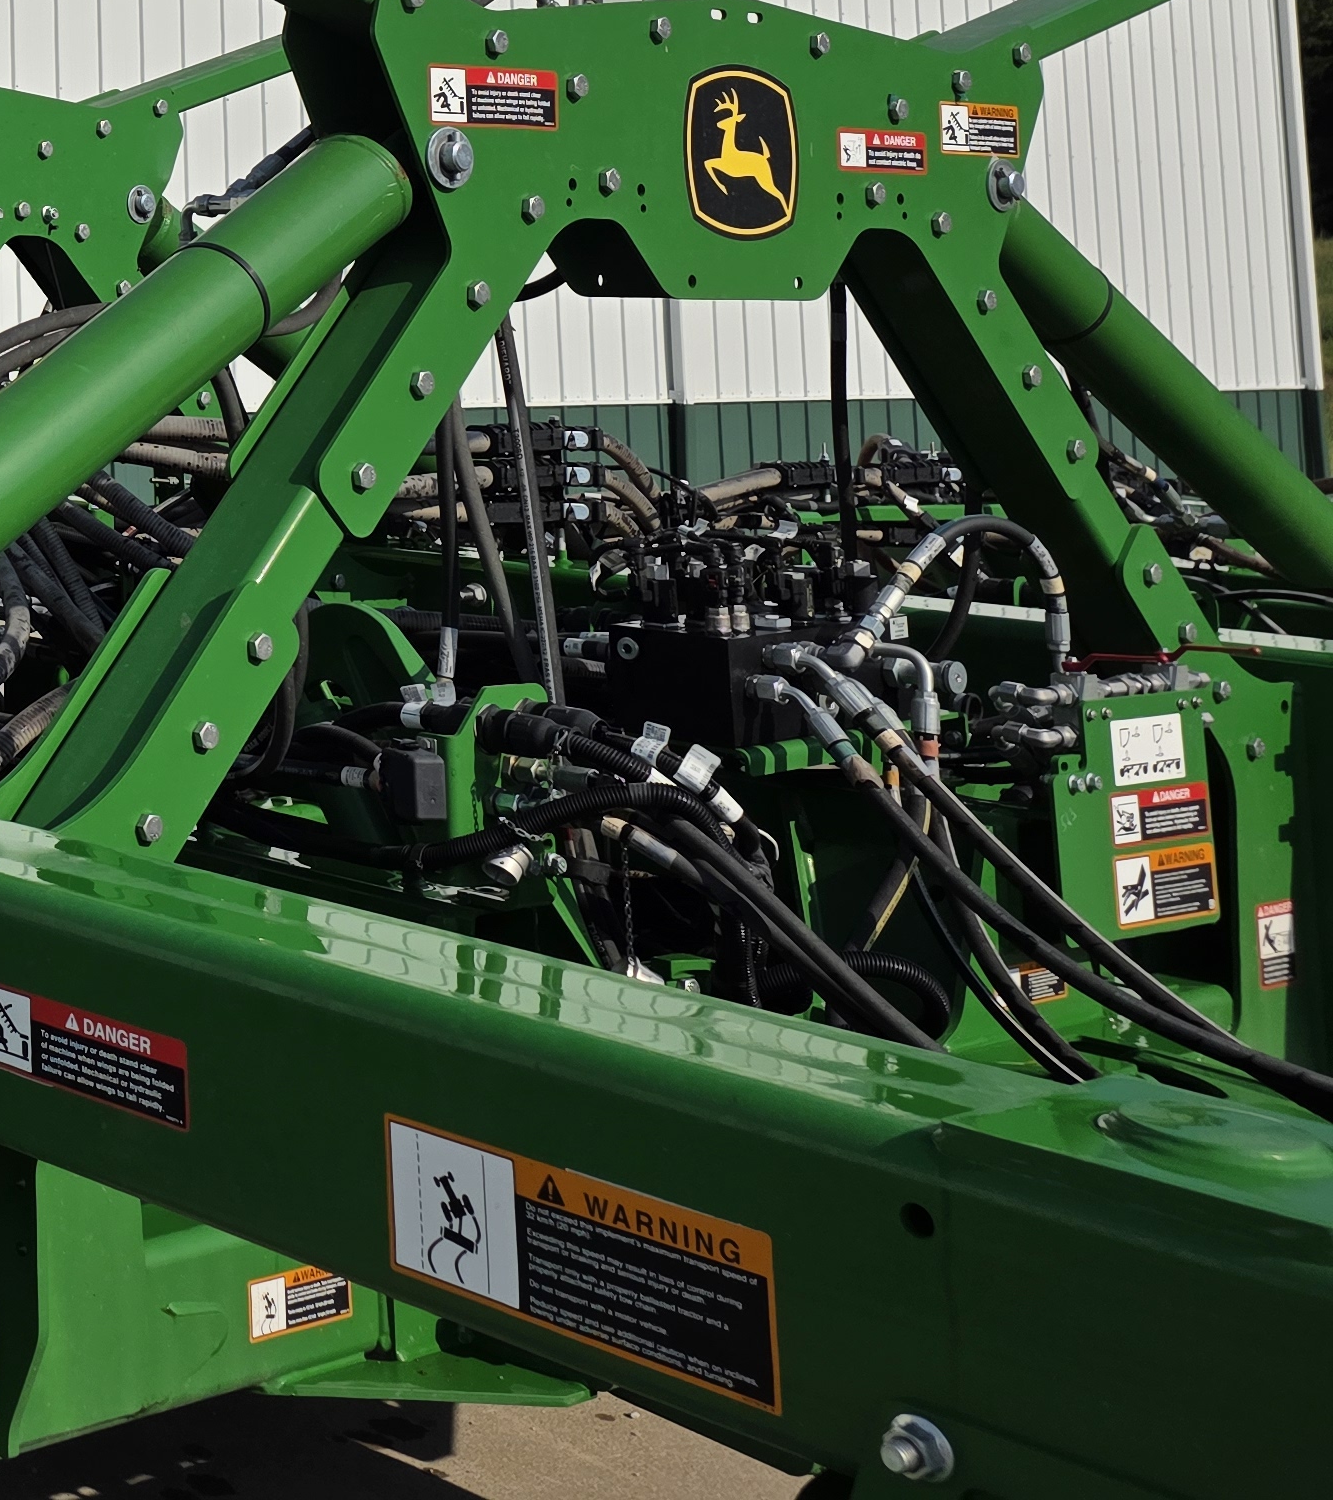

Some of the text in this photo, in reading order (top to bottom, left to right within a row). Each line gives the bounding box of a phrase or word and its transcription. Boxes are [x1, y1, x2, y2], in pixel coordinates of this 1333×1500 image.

[498, 72, 537, 86] DANGER
[980, 107, 1014, 118] WARNING
[884, 135, 916, 146] DANGER
[1160, 788, 1190, 801] DANGER
[1164, 848, 1205, 865] WARNING
[41, 1029, 49, 1038] To
[50, 1035, 68, 1045] avoid
[69, 1040, 89, 1053] injury
[98, 1050, 118, 1061] death
[119, 1057, 139, 1068] stand
[139, 1064, 157, 1074] clear
[83, 1017, 151, 1055] DANGER
[41, 1063, 165, 1112] failure can allow wings to fall rapidly.
[48, 1045, 76, 1058] machine
[77, 1055, 95, 1065] when
[96, 1061, 117, 1073] wings
[118, 1068, 130, 1076] are
[130, 1071, 150, 1085] being
[151, 1078, 174, 1092] folded
[49, 1057, 80, 1071] unfolded.
[81, 1066, 119, 1084] Mechanical
[129, 1082, 162, 1099] hydraulic
[525, 1201, 536, 1212] Do
[537, 1208, 549, 1216] not
[550, 1212, 578, 1226] exceed
[579, 1221, 594, 1231] this
[642, 1243, 682, 1260] maximum
[683, 1256, 720, 1273] transport
[721, 1269, 747, 1282] speed
[583, 1192, 740, 1265] WARNING
[526, 1237, 560, 1252] transport
[600, 1263, 616, 1273] and
[617, 1269, 646, 1283] serious
[647, 1280, 669, 1292] injury
[526, 1228, 565, 1248] Exceeding
[566, 1242, 580, 1252] this
[581, 1248, 606, 1261] speed
[606, 1257, 623, 1268] may
[625, 1264, 647, 1275] result
[658, 1274, 675, 1285] loss
[686, 1285, 714, 1298] control
[716, 1294, 743, 1309] during
[528, 1263, 558, 1279] properly
[559, 1275, 592, 1290] attached
[593, 1287, 617, 1300] safety
[618, 1295, 633, 1305] tow
[528, 1253, 563, 1271] Transport
[564, 1268, 580, 1279] only
[581, 1274, 598, 1283] with
[606, 1283, 638, 1299] properly
[639, 1293, 676, 1311] ballasted
[677, 1307, 703, 1320] tractor
[705, 1318, 722, 1328] and
[529, 1278, 540, 1288] Do
[541, 1285, 553, 1294] not
[554, 1289, 588, 1306] transport
[589, 1303, 606, 1312] with
[614, 1312, 637, 1323] motor
[529, 1296, 558, 1312] Reduce
[559, 1309, 583, 1321] speed
[584, 1318, 599, 1328] and
[600, 1324, 615, 1333] use
[616, 1330, 655, 1347] additional
[656, 1344, 686, 1359] caution
[687, 1356, 710, 1368] when
[711, 1365, 722, 1373] on
[555, 1316, 577, 1327] under
[578, 1325, 610, 1340] adverse
[611, 1336, 640, 1351] surface
[686, 1364, 702, 1374] and
